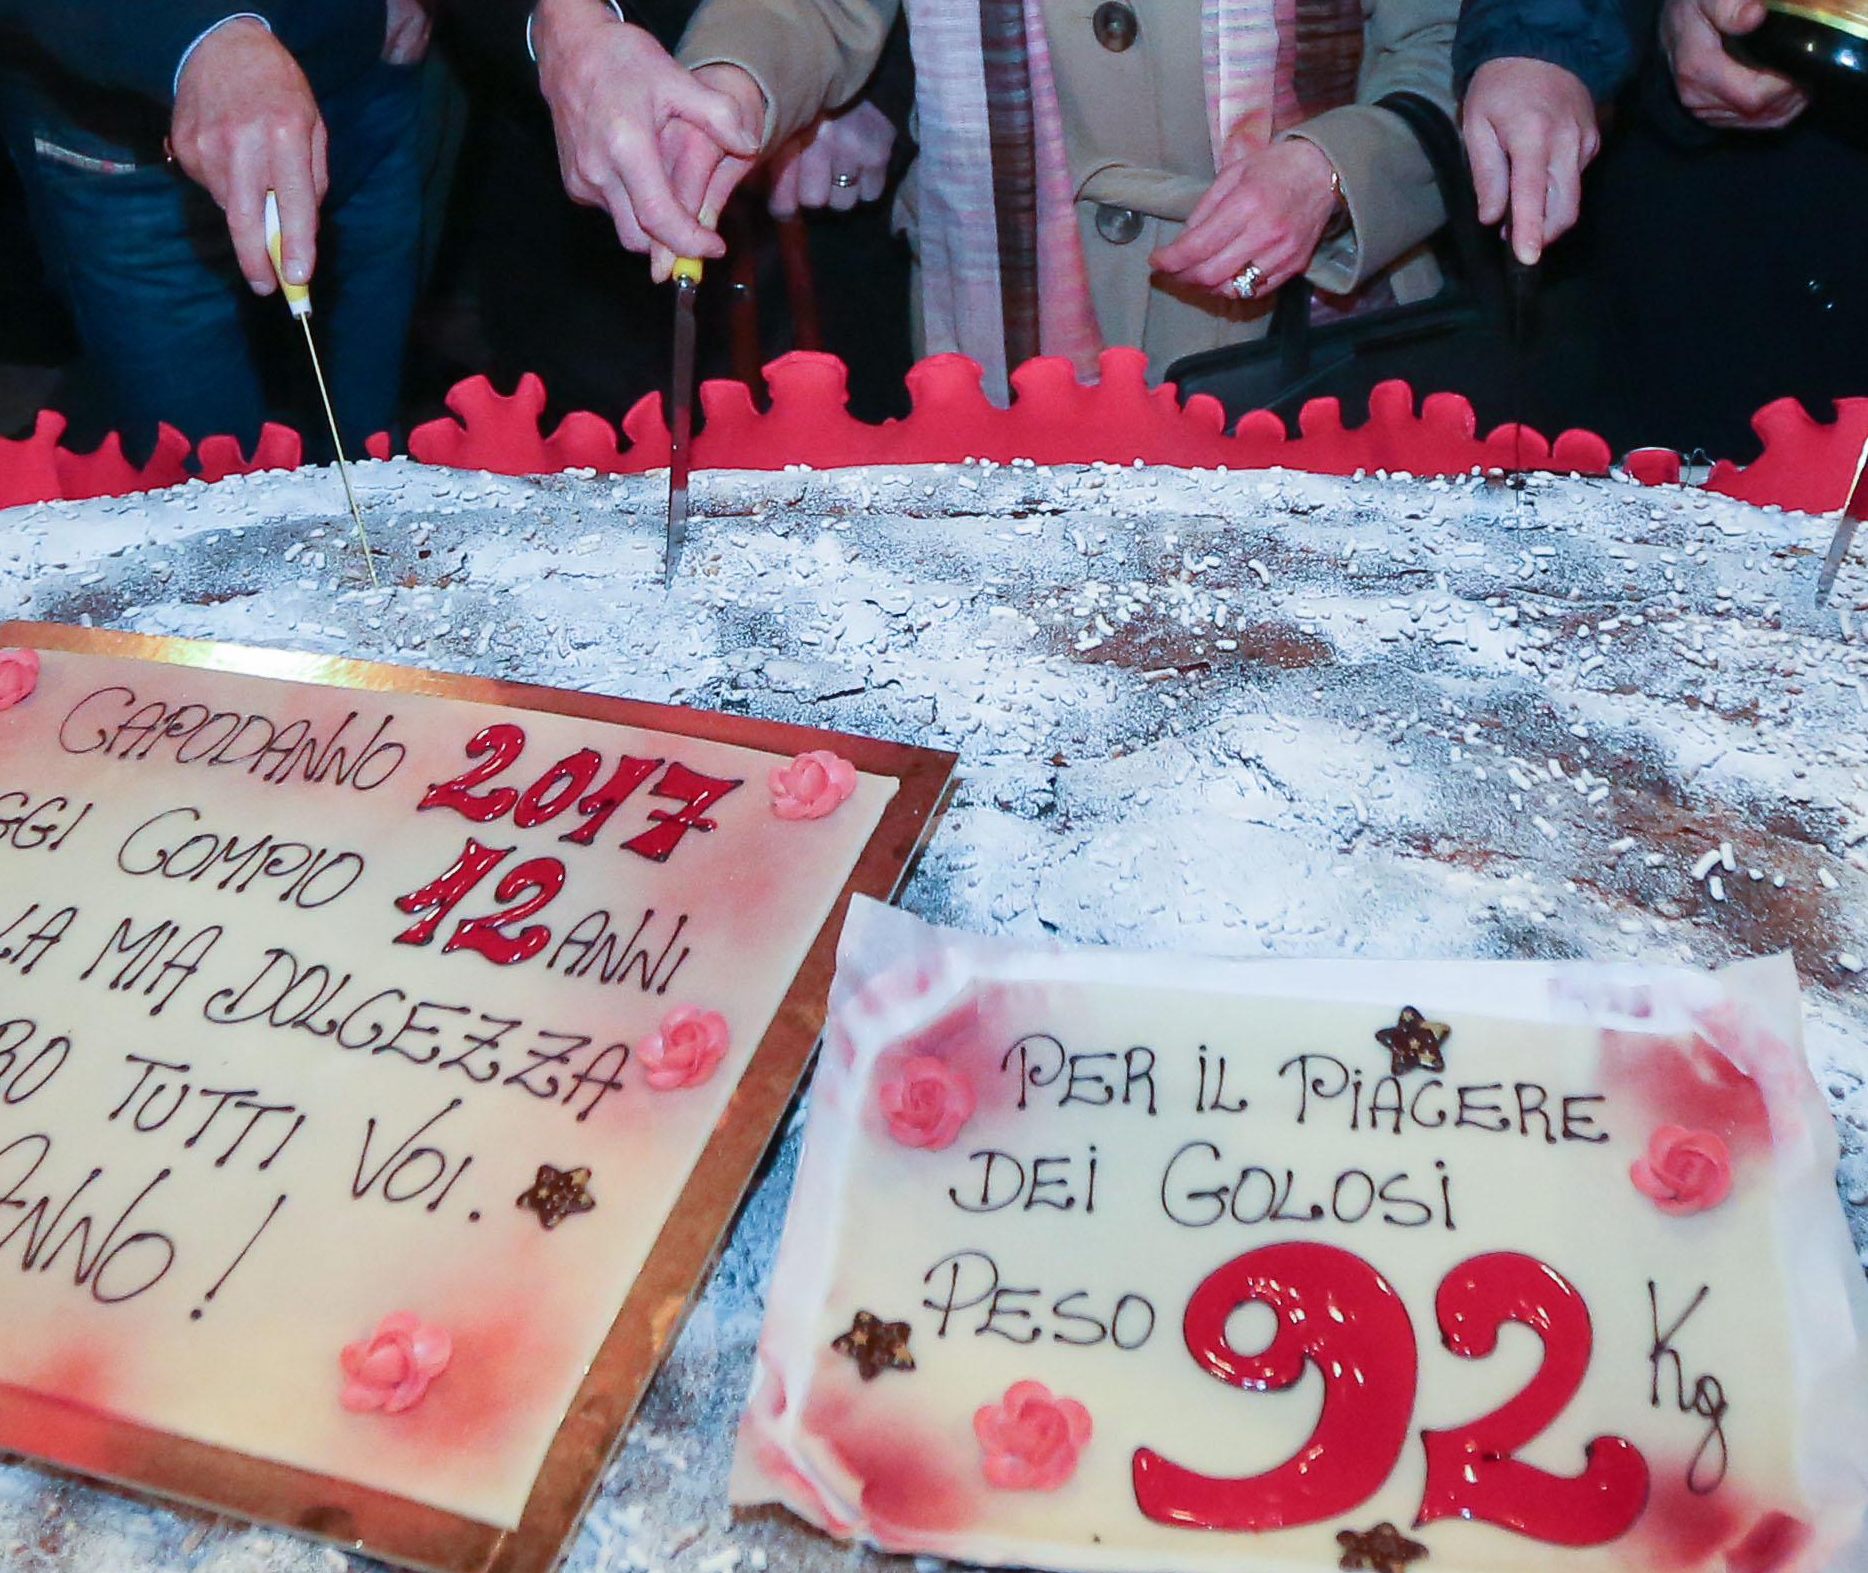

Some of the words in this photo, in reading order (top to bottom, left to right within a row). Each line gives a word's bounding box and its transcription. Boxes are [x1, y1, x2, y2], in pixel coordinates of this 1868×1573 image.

[59, 684, 408, 794] CAPODANNO
[417, 720, 745, 865] 2017
[118, 806, 366, 909] COMPIO
[393, 836, 567, 968] 12
[544, 910, 691, 995] ANNI
[80, 917, 225, 1016] MIA
[204, 949, 632, 1123] DOLCEZZA
[1001, 1034, 1159, 1114] PER
[109, 1055, 307, 1174] TUTTI
[921, 1250, 1157, 1351] PESO
[1133, 1241, 1649, 1547] 92
[1646, 1278, 1730, 1495] Kg
